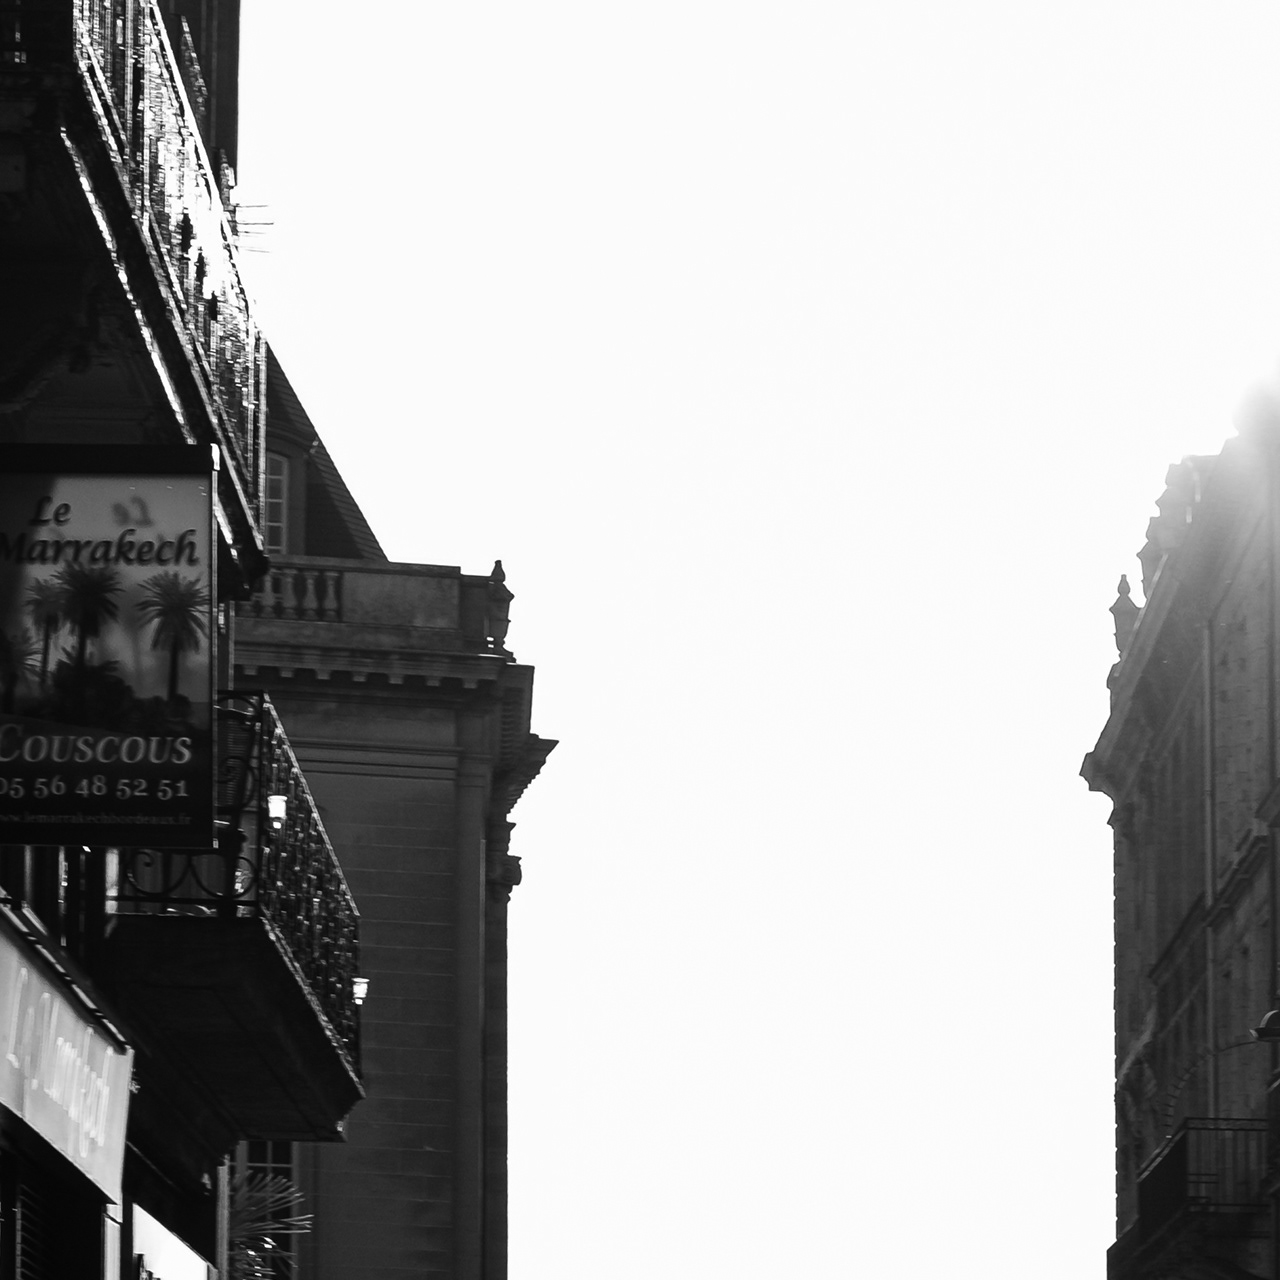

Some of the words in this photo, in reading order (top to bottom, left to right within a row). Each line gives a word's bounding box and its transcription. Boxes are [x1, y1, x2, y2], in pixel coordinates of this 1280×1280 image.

[29, 496, 72, 526] Le
[33, 775, 65, 798] 56
[75, 774, 108, 796] 48
[116, 777, 149, 799] 52
[157, 777, 189, 800] 51
